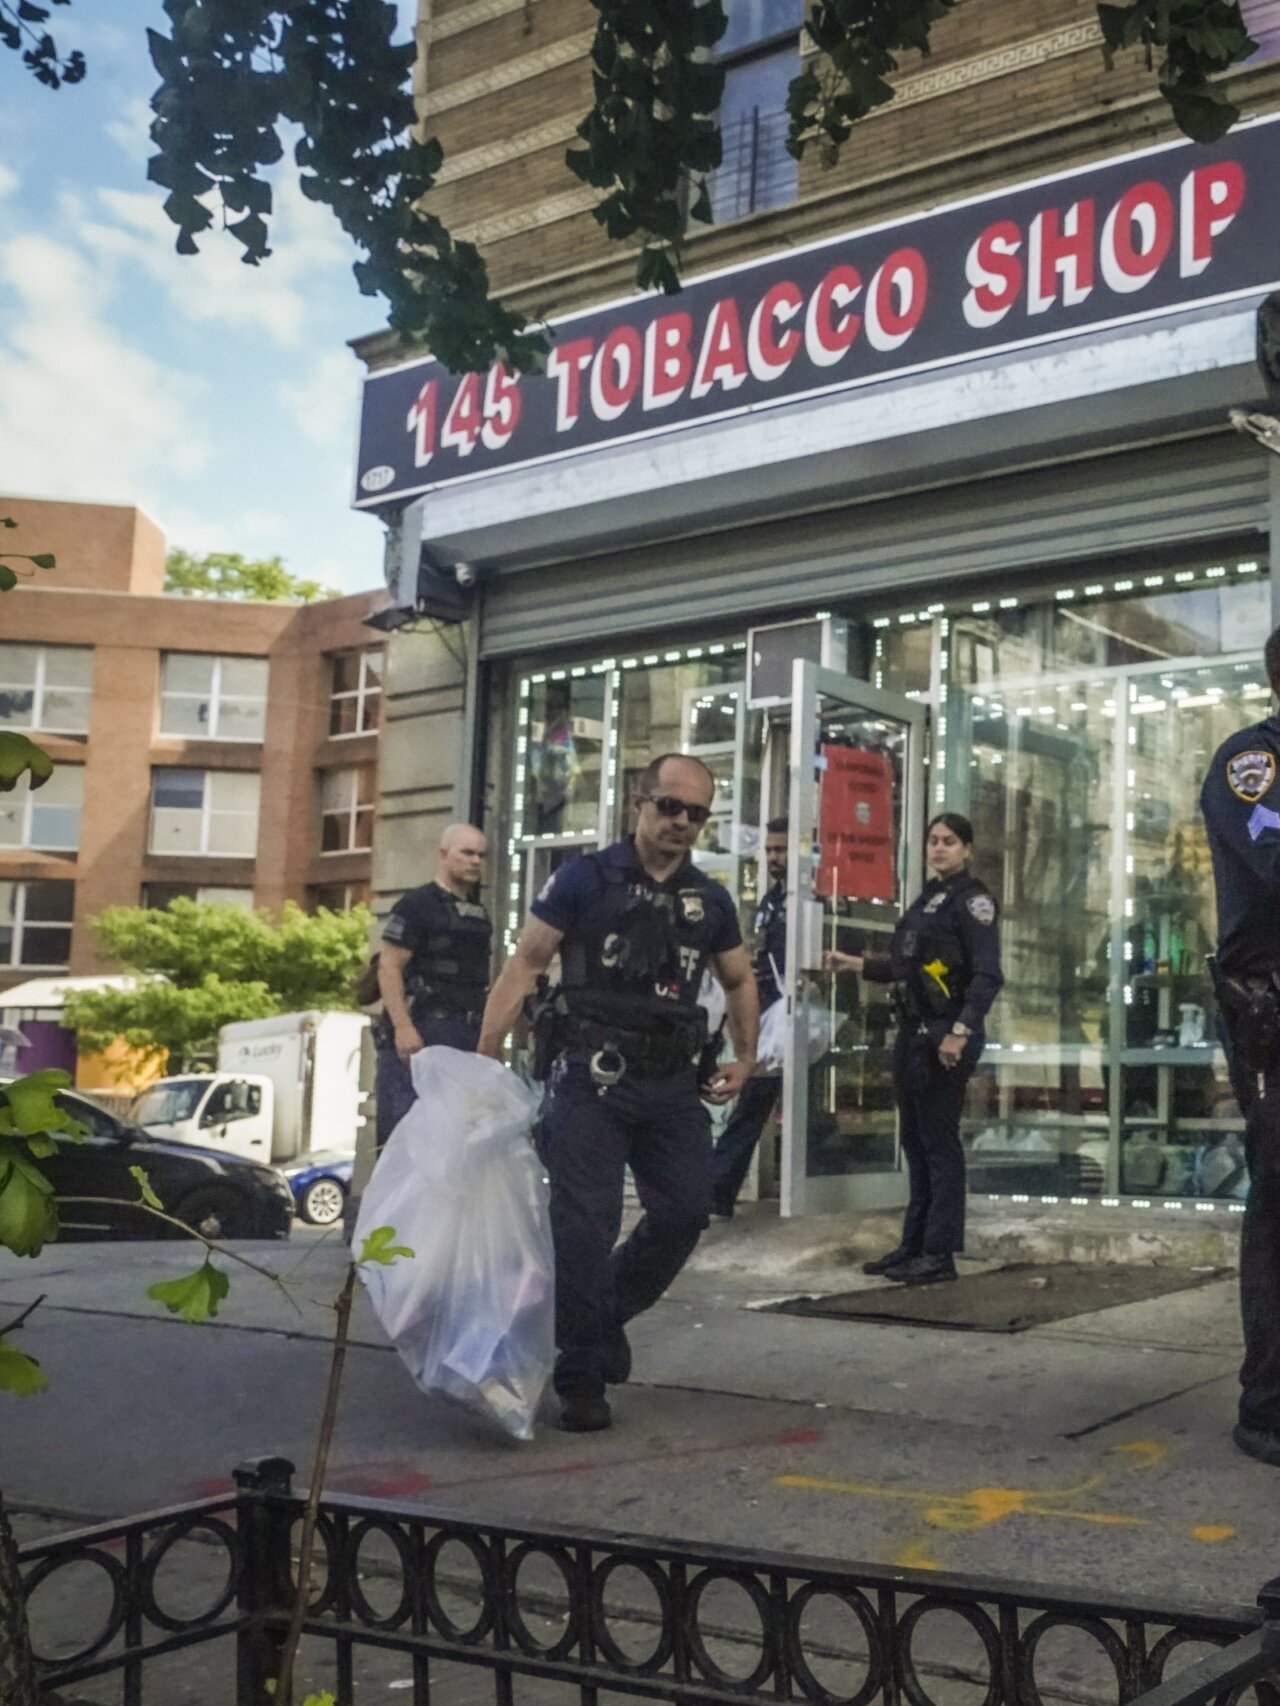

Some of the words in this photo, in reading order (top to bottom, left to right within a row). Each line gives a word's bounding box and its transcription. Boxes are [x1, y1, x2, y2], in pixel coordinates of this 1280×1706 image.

[407, 360, 522, 467] 145
[547, 247, 928, 432] TOBACCO
[962, 160, 1246, 328] SHOP
